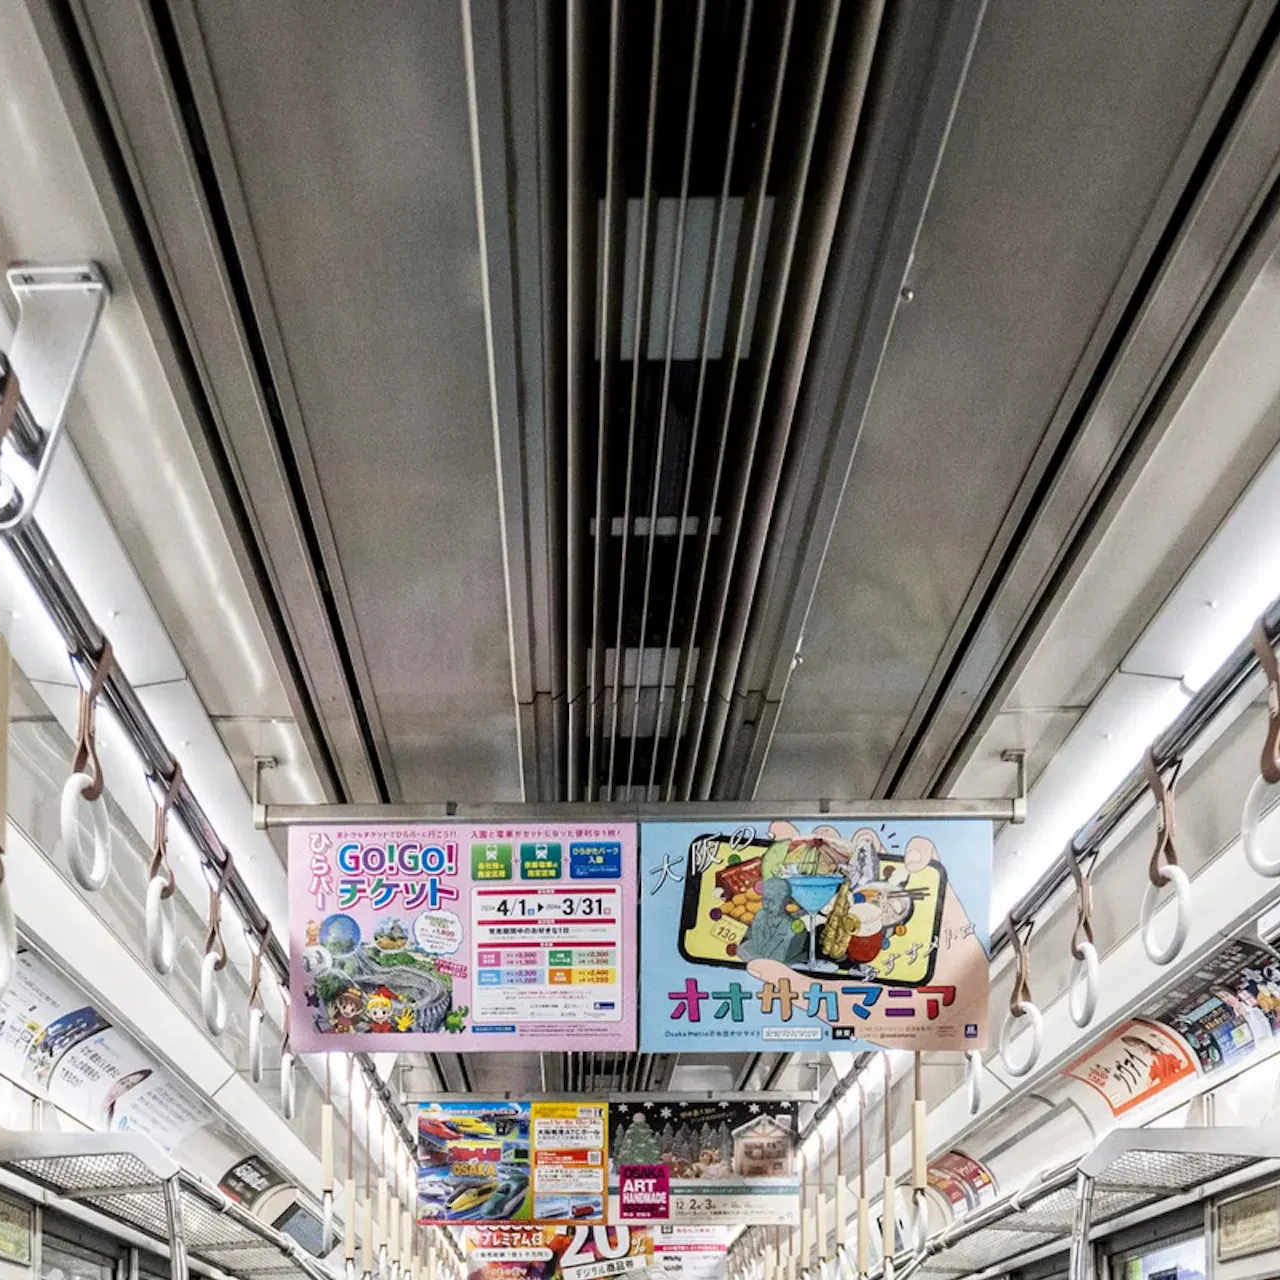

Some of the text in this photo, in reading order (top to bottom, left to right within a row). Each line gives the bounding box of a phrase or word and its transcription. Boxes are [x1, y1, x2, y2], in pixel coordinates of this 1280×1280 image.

[649, 824, 758, 896] 大阪の
[309, 832, 333, 911] ひらパー
[338, 876, 458, 909] チケット
[497, 898, 526, 916] 4/1
[562, 897, 603, 916] 3/31
[668, 977, 957, 1023] オオサカマニア
[452, 1163, 498, 1177] OSAKA
[624, 1168, 666, 1178] OSAKA
[623, 1179, 658, 1192] ART
[622, 1191, 667, 1204] HANDMADE
